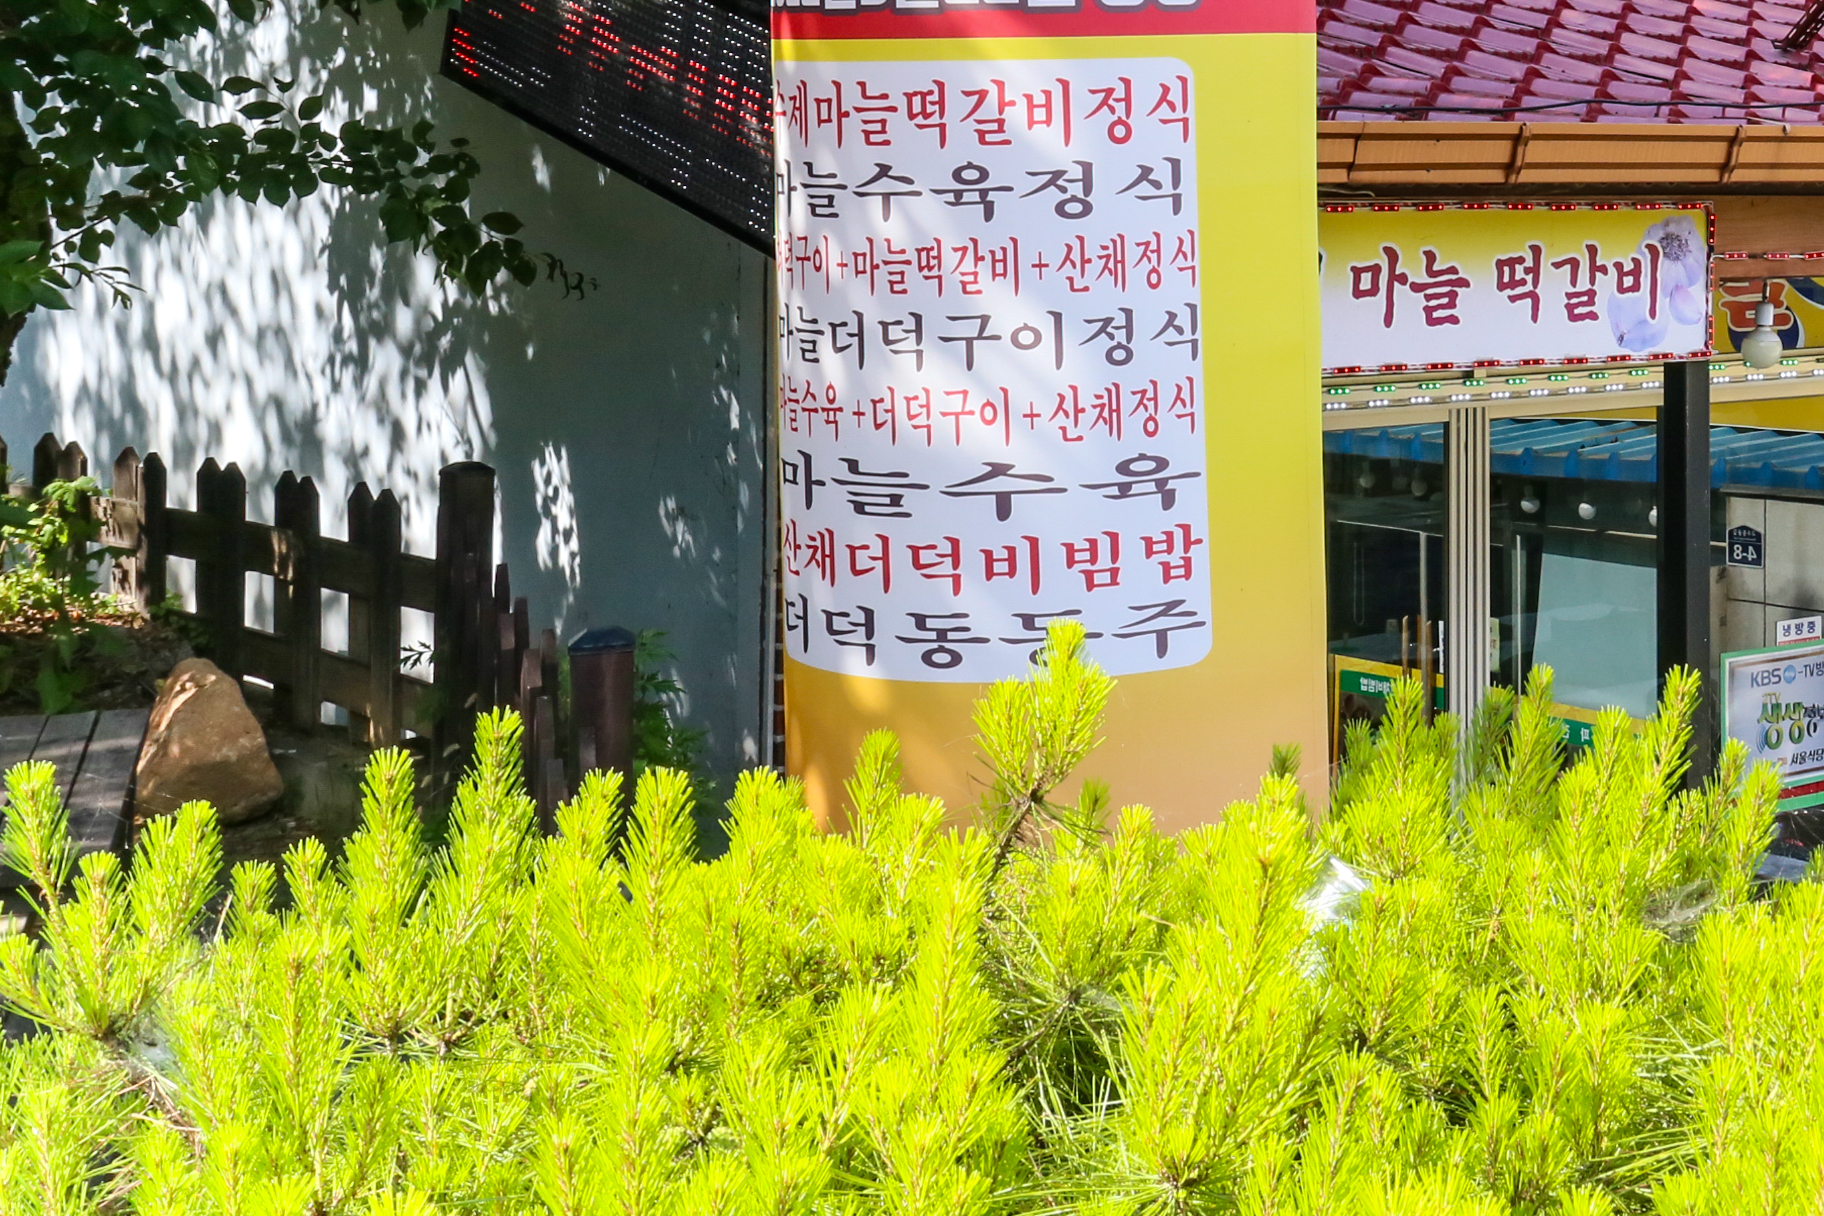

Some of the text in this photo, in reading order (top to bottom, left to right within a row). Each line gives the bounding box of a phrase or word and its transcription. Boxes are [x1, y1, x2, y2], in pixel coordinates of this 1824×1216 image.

[775, 74, 1192, 151] 수제마늘떡갈비정식
[776, 156, 1183, 224] 마늘수육정식
[1350, 244, 1471, 329] 마늘
[1494, 242, 1662, 325] 떡갈비
[779, 301, 1201, 373] 마늘더덕구이정식
[780, 449, 1203, 522] 마늘수육
[783, 517, 1203, 597] 산채더덕비빔밥
[1782, 620, 1816, 637] 냉방중
[1750, 667, 1782, 689] KBS
[1790, 748, 1824, 766] 서울식당
